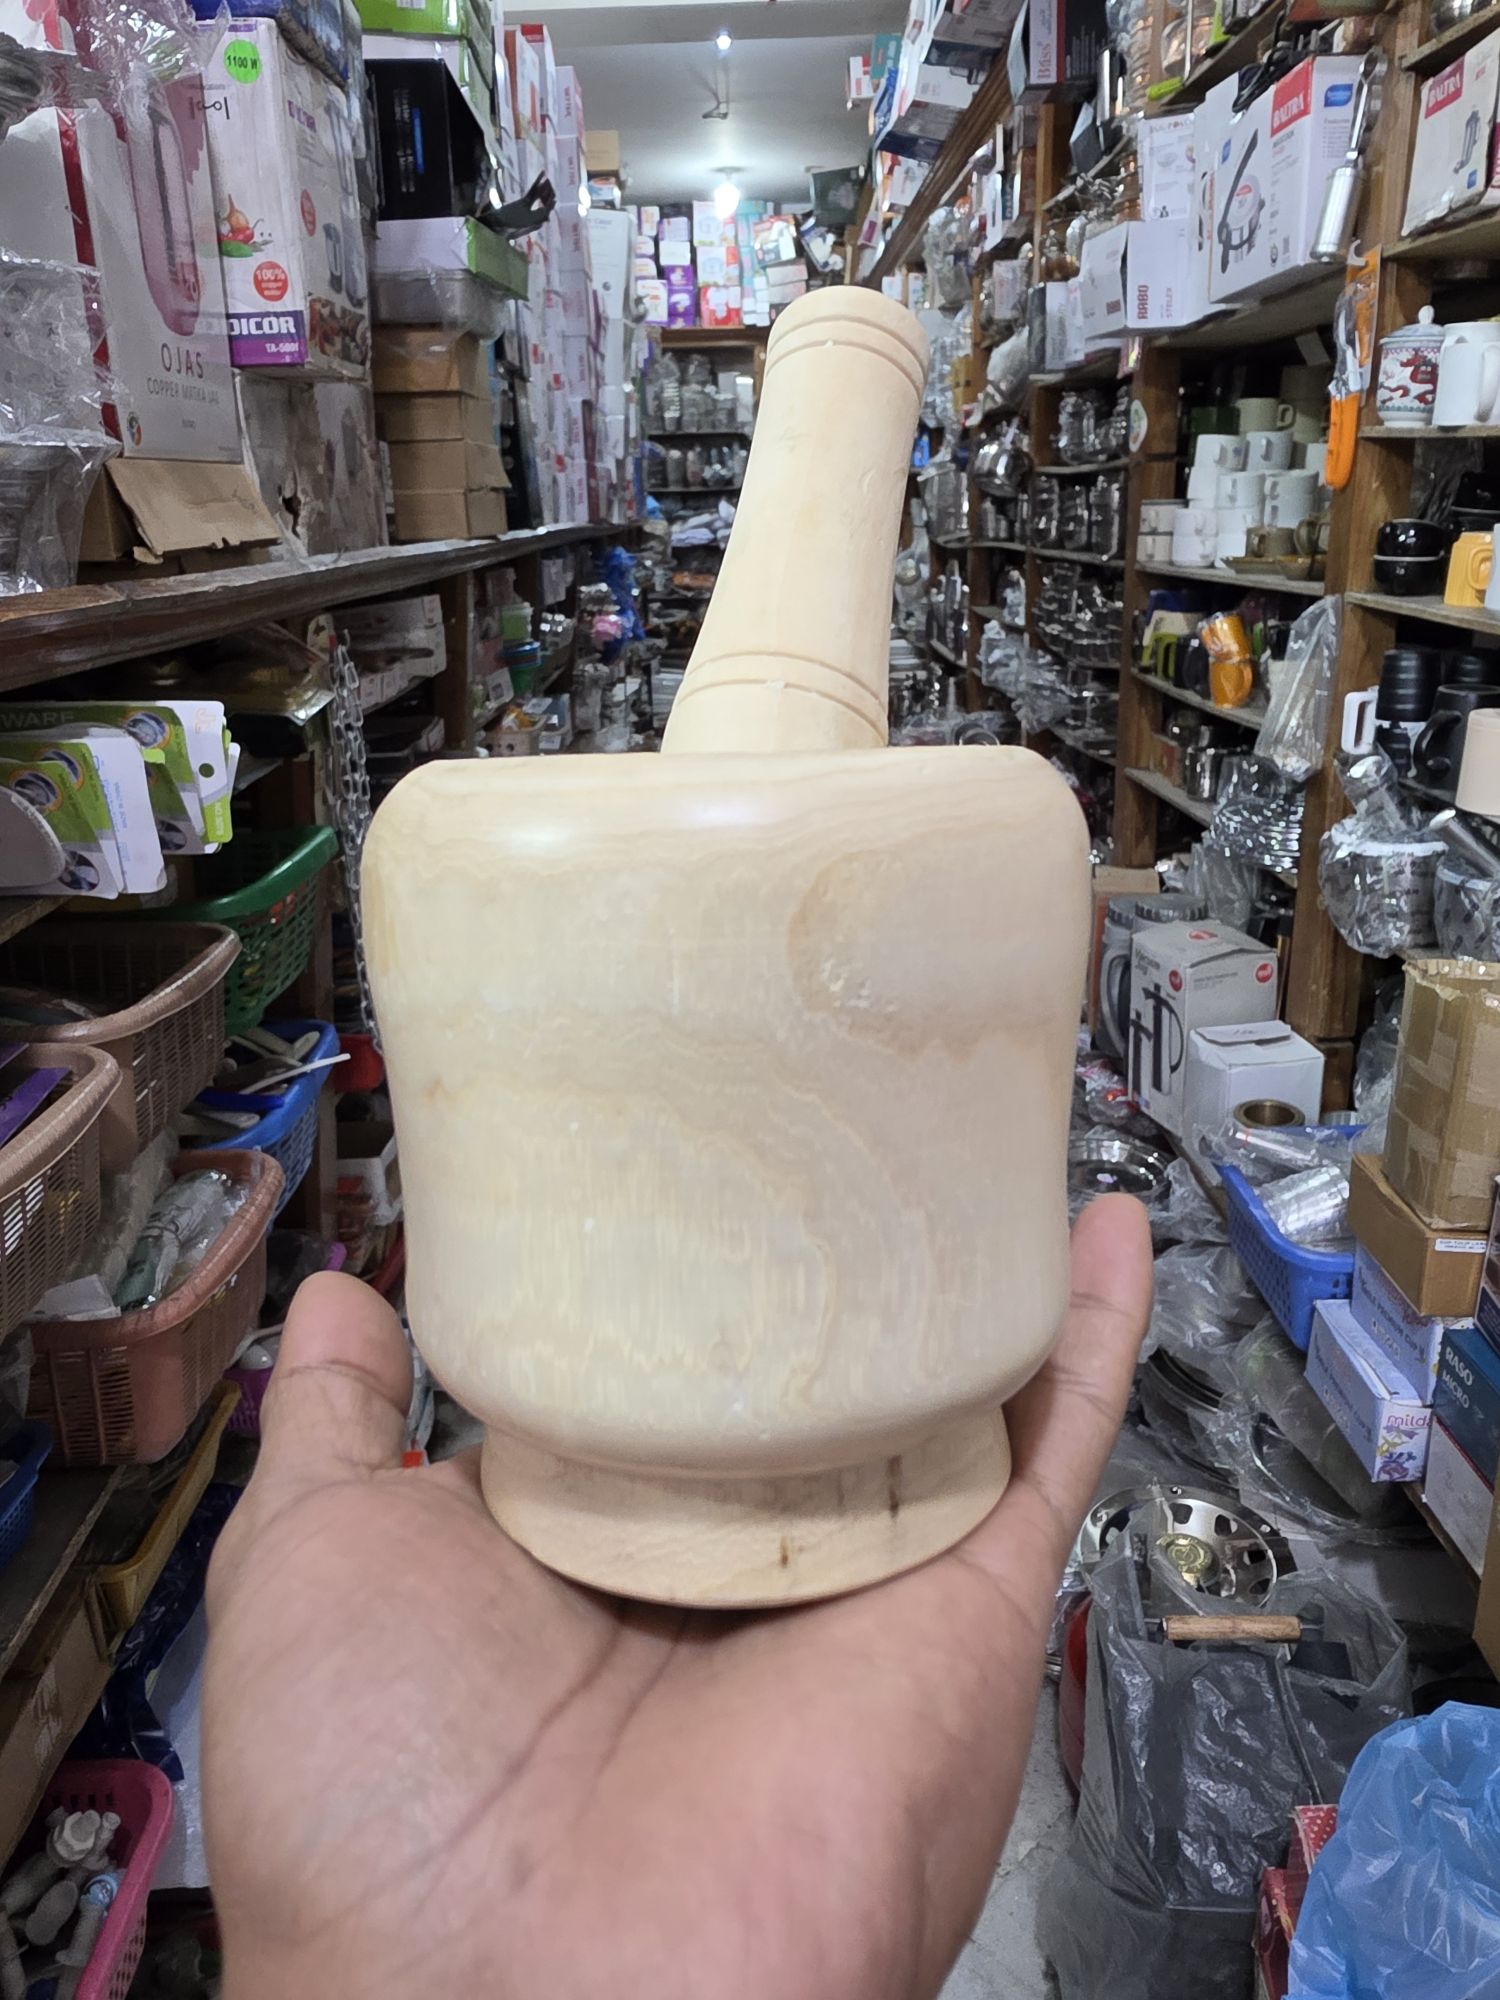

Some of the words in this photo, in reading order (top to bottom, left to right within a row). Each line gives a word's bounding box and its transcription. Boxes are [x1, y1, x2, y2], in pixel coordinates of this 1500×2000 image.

[226, 55, 248, 69] 1100
[161, 342, 204, 379] OJAS
[1445, 1346, 1473, 1387] RASO
[1441, 1369, 1470, 1409] MICRO
